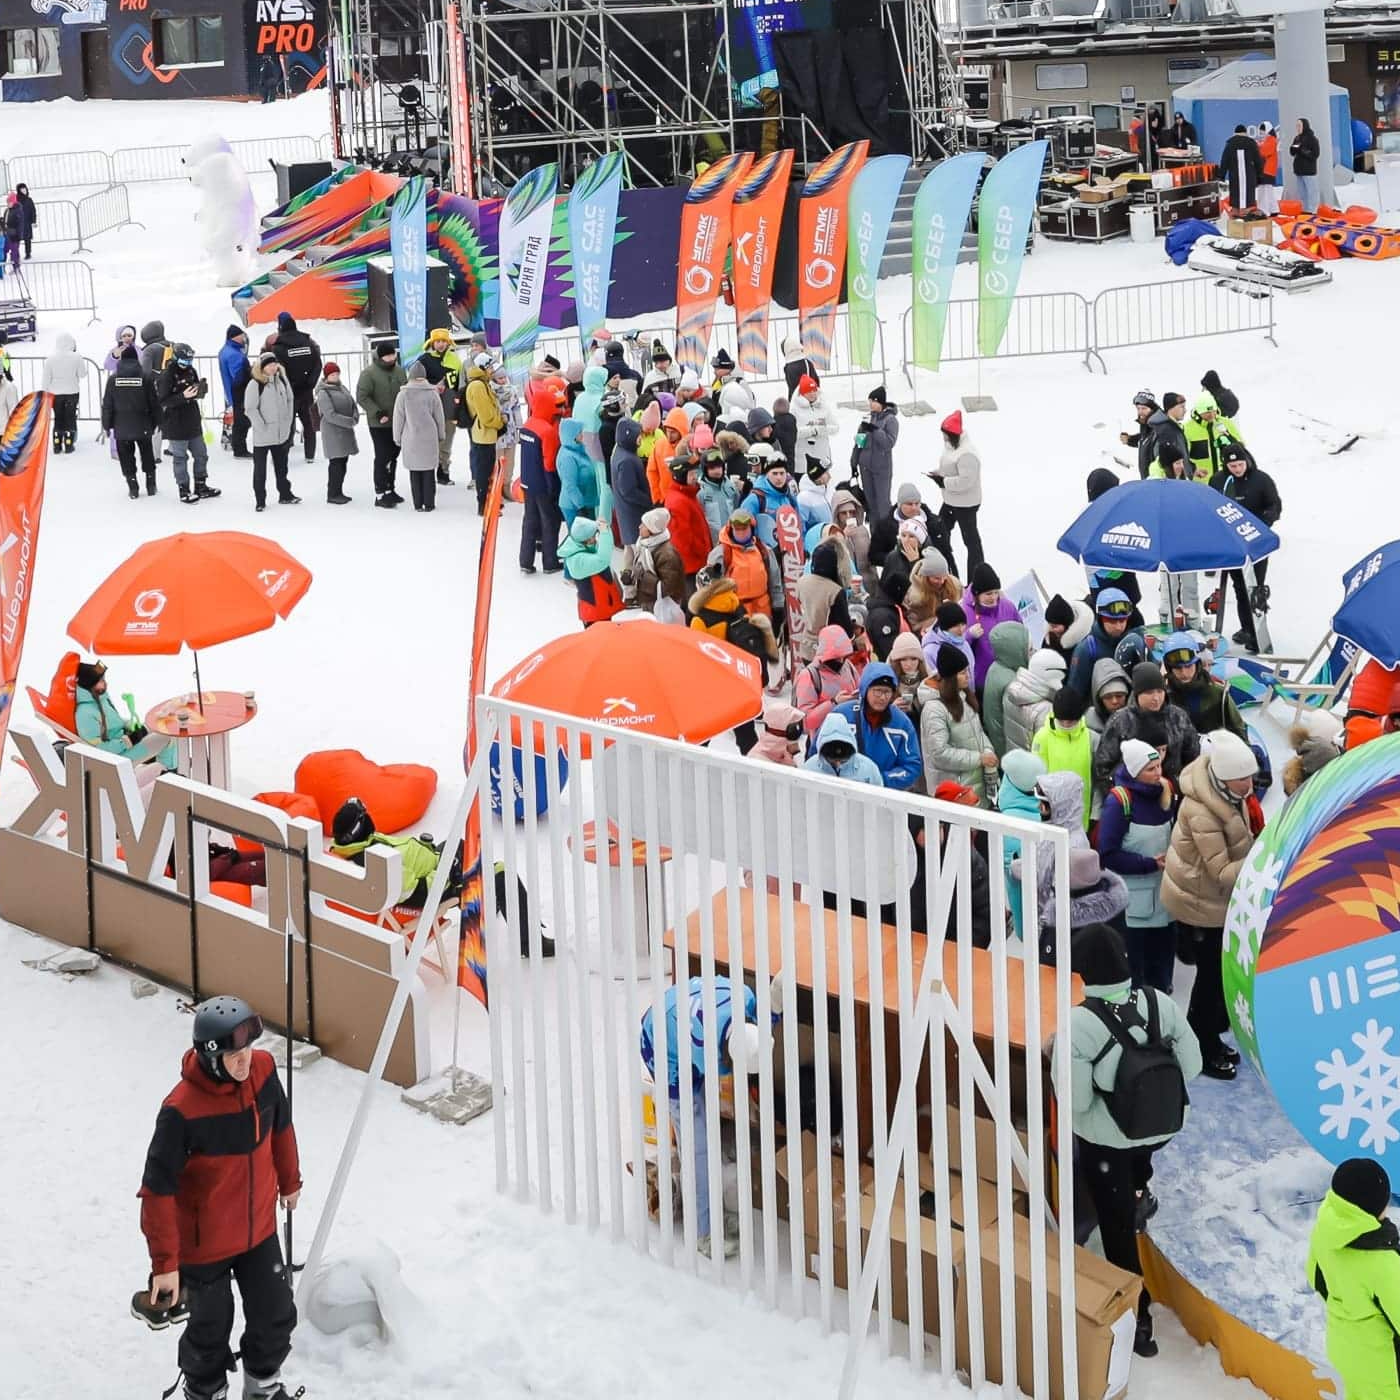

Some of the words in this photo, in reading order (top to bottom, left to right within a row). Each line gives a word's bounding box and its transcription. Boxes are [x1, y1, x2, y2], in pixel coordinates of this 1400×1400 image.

[256, 23, 315, 54] PRO
[526, 235, 543, 265] ГРАД
[581, 204, 599, 253] САС
[691, 213, 710, 262] УГМК
[812, 205, 829, 255] УГМК
[923, 213, 948, 274] СБЕР
[992, 205, 1014, 265] СБЕР
[518, 267, 535, 305] ШОРИЯ
[582, 260, 594, 308] САС
